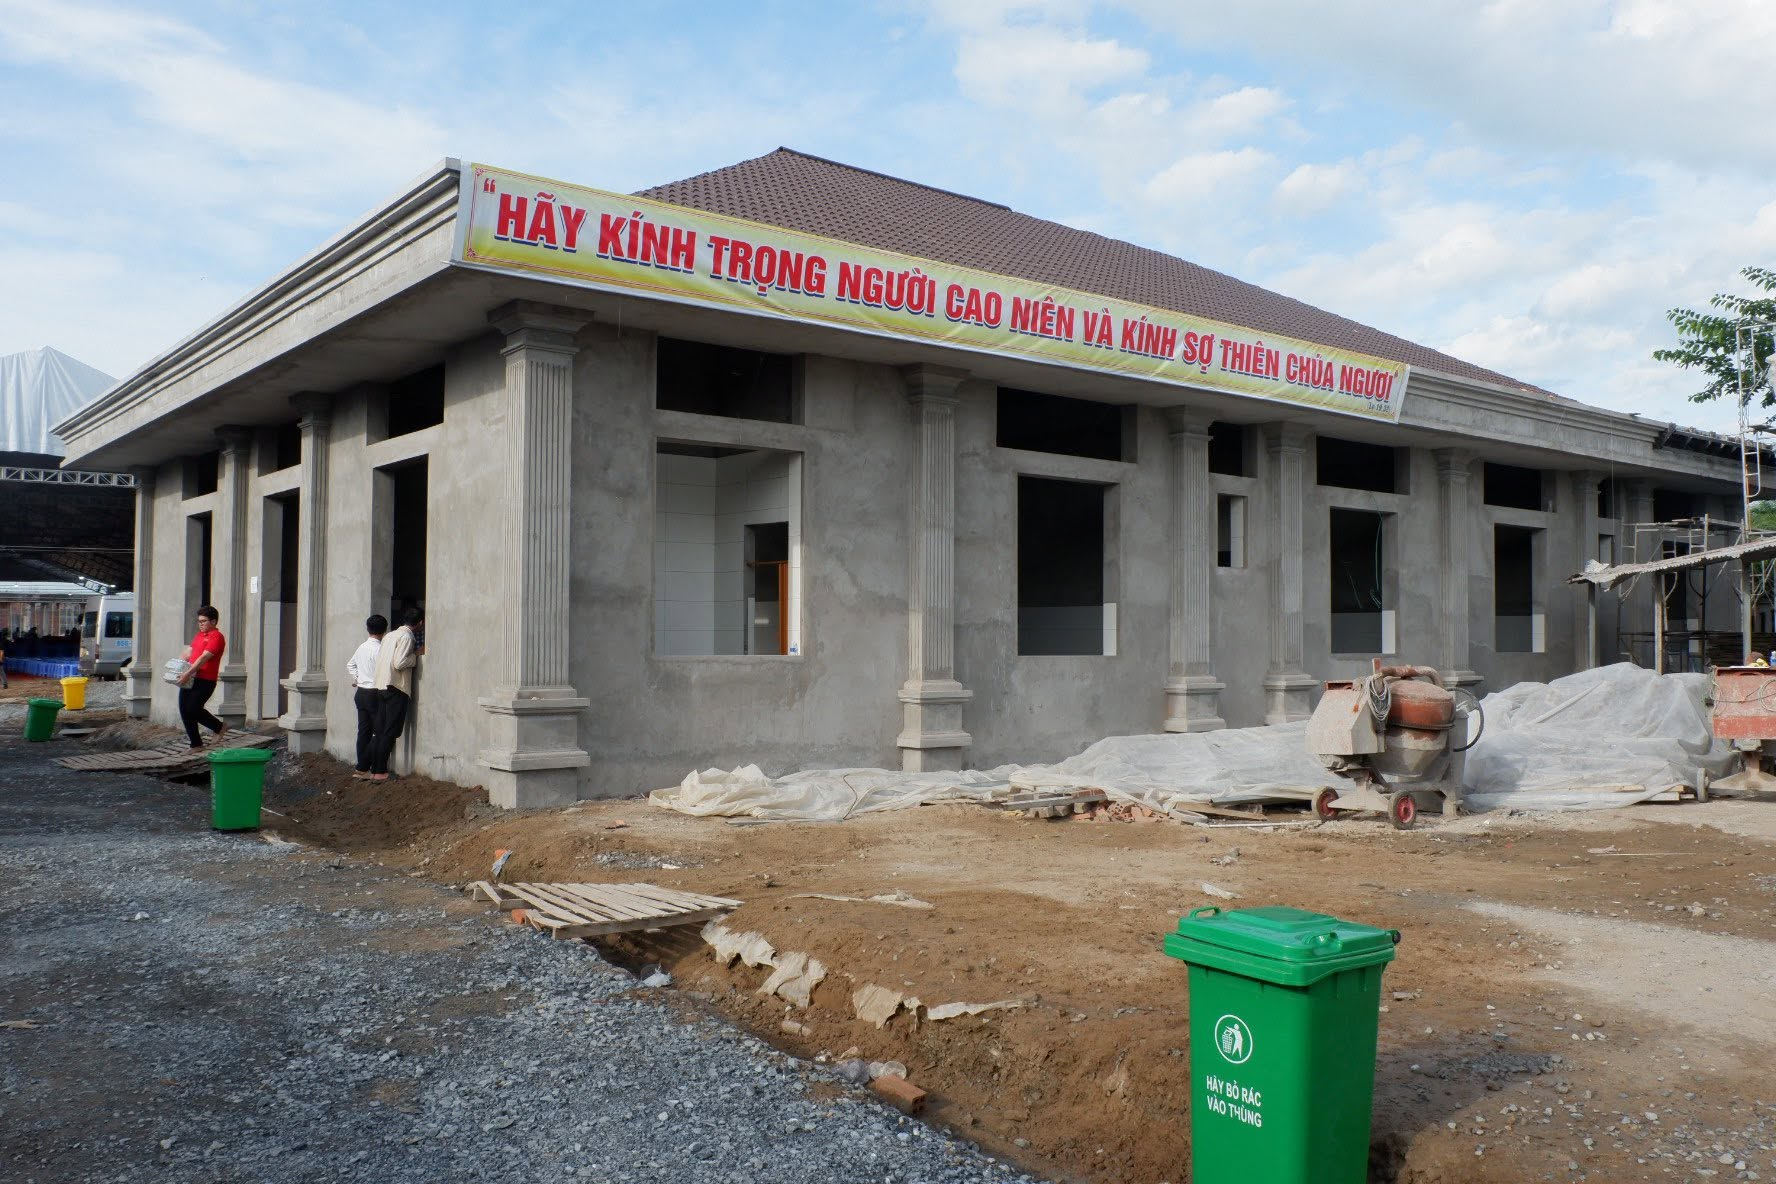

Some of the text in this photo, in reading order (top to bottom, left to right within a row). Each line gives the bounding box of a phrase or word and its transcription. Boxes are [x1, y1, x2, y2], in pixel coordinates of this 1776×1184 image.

[596, 211, 696, 274] KÍNH
[707, 235, 827, 297] TRỌNG
[836, 261, 936, 317] NGƯỜI
[944, 283, 1003, 328] CAO
[1009, 296, 1075, 342] NIÊN
[1083, 308, 1114, 350] VÀ
[1119, 316, 1177, 361] KÍNH
[1182, 331, 1216, 374] SỢ
[1219, 340, 1280, 380] THIÊN
[1285, 354, 1335, 392] CHÚA
[1206, 1094, 1262, 1128] VÀO THÙNG
[1241, 1087, 1262, 1107] RÁC
